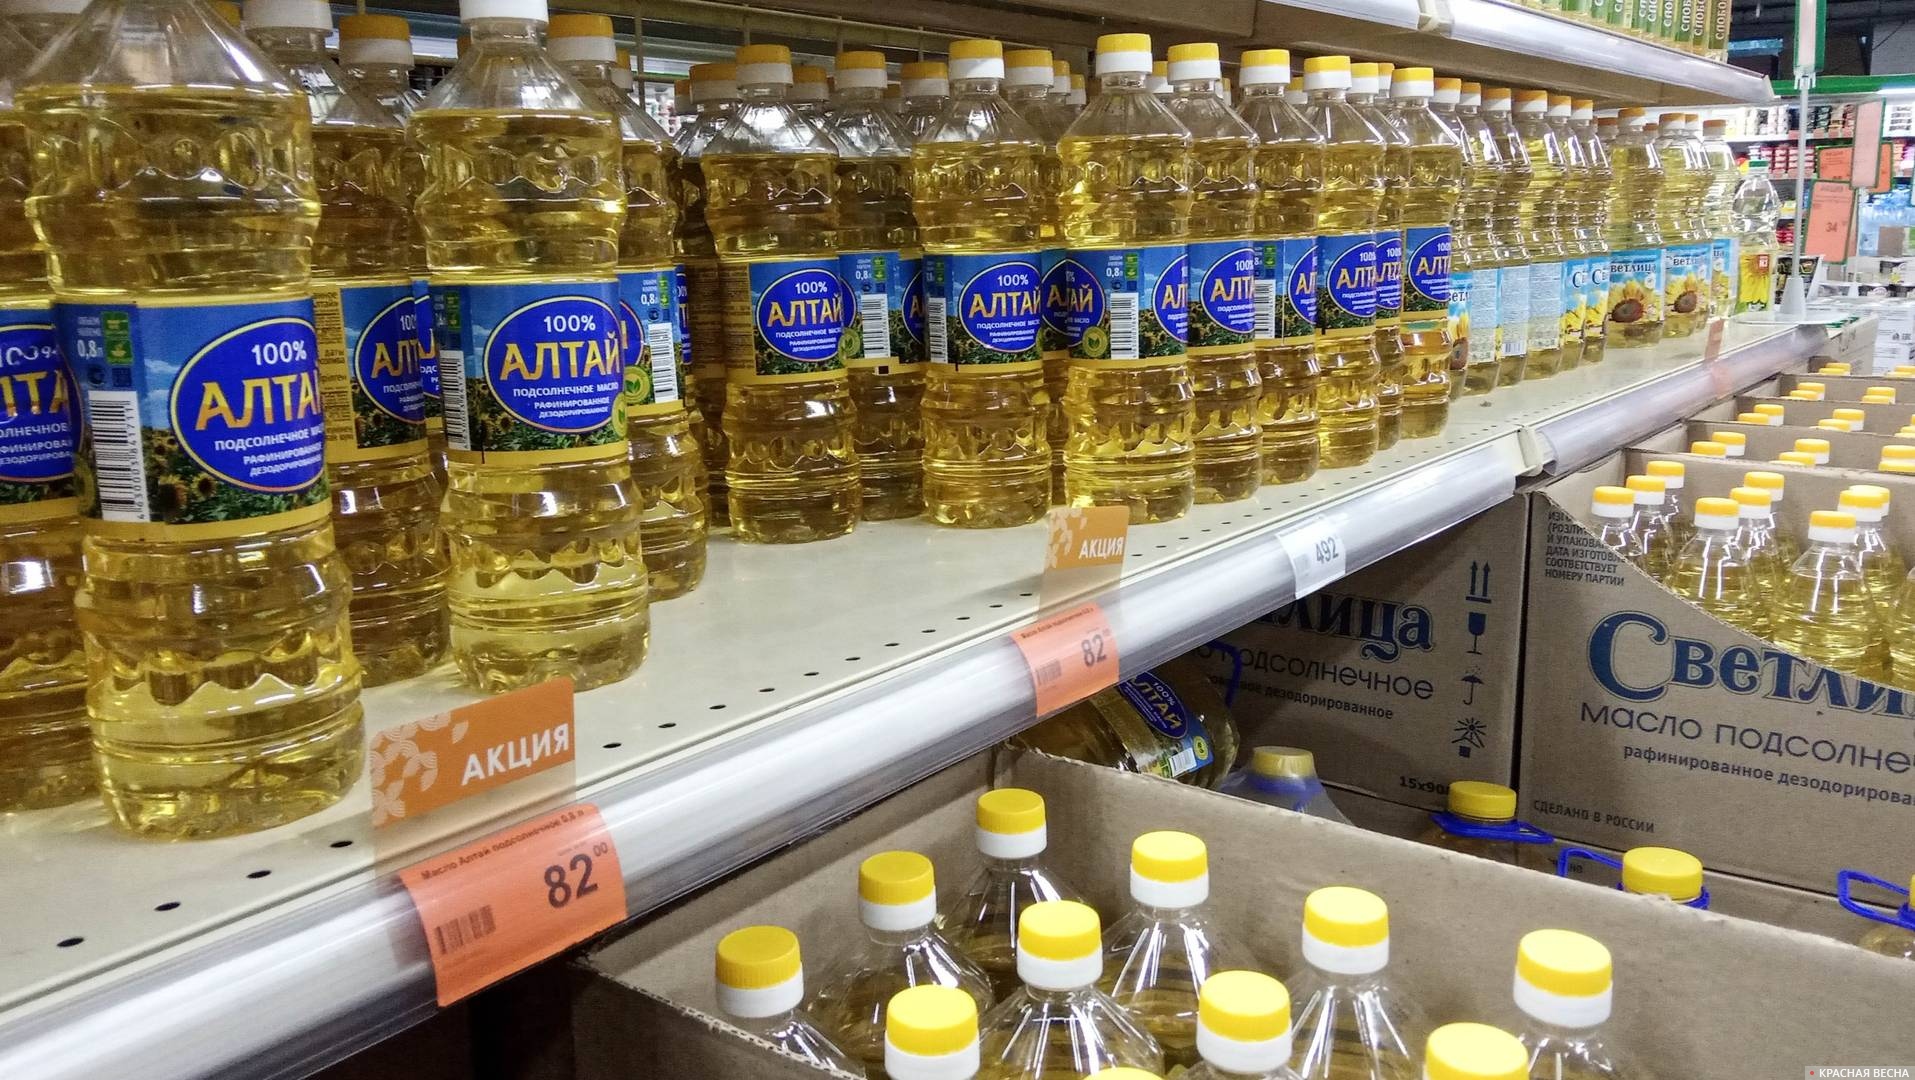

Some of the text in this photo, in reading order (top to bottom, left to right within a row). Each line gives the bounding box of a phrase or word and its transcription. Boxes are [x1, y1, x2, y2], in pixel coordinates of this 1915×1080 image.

[795, 281, 828, 294] 100%
[997, 274, 1029, 287] 100%
[767, 292, 843, 327] АЛТАЙ
[968, 286, 1040, 318] АЛТАЙ
[543, 315, 596, 333] 100%
[251, 340, 307, 366] 100%
[500, 330, 620, 381] АЛТАЙ
[513, 384, 594, 399] ПОДСОЛНЕЧНОЕ
[534, 396, 610, 409] РАФИНИРОВАННОЕ
[214, 428, 310, 452] ПОДСОЛНЕЧНОЕ
[1078, 536, 1124, 560] АКЦИЯ
[1315, 537, 1339, 564] 492
[1546, 545, 1569, 557] ДАТА
[1545, 557, 1618, 573] СООТВЕТСТВУЕТ
[1545, 569, 1625, 586] НОМЕРУ ПАРТИИ
[1081, 634, 1107, 668] 82
[1587, 610, 1915, 719] Светли
[1265, 684, 1394, 719] дезодорированное
[461, 722, 569, 786] АКЦИЯ
[1623, 745, 1774, 781] рафинированное
[1715, 723, 1915, 774] подсолне
[1534, 800, 1655, 833] СДЕЛАНО В РОССИИ
[421, 861, 458, 880] Масло
[458, 846, 491, 866] Алтай
[491, 818, 561, 851] подсолнечное
[544, 853, 599, 909] 82
